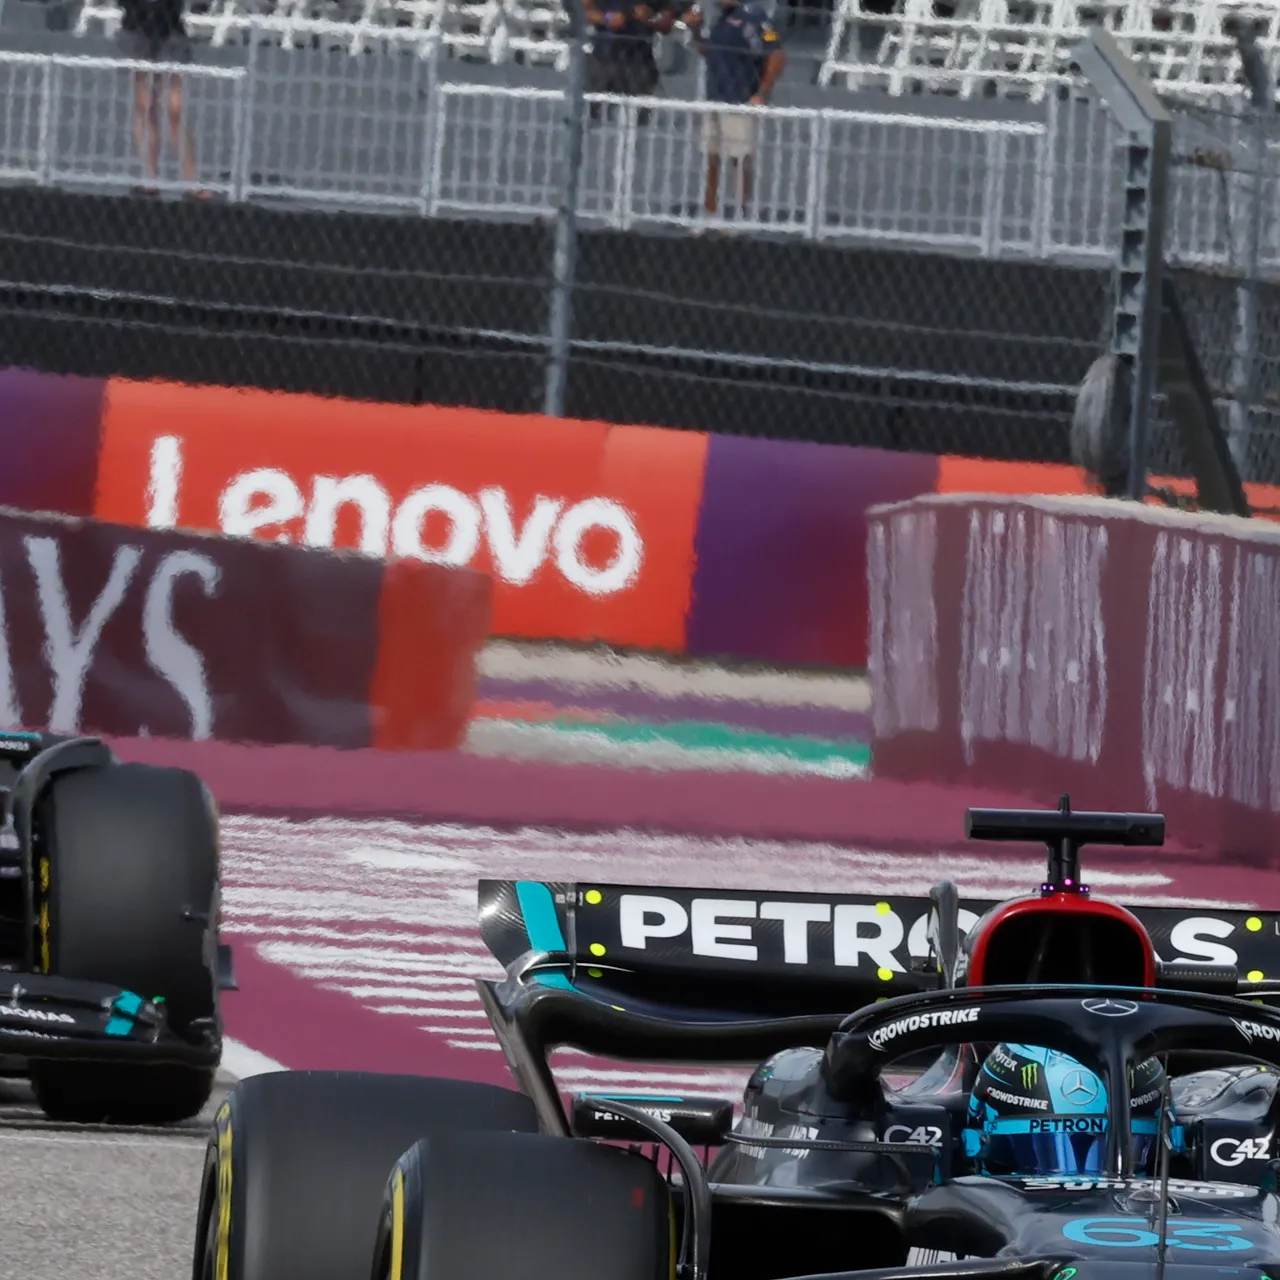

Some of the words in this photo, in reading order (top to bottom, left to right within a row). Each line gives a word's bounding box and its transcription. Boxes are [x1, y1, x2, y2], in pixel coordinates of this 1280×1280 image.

[146, 434, 644, 598] Lenovo
[619, 894, 1239, 974] PETRS
[872, 1007, 981, 1045] CROWDSTRIKE
[986, 1086, 1049, 1110] CROWDSTRIKE
[1029, 1118, 1108, 1133] PETRON
[1210, 1137, 1271, 1167] G42
[1062, 1217, 1255, 1252] 63
